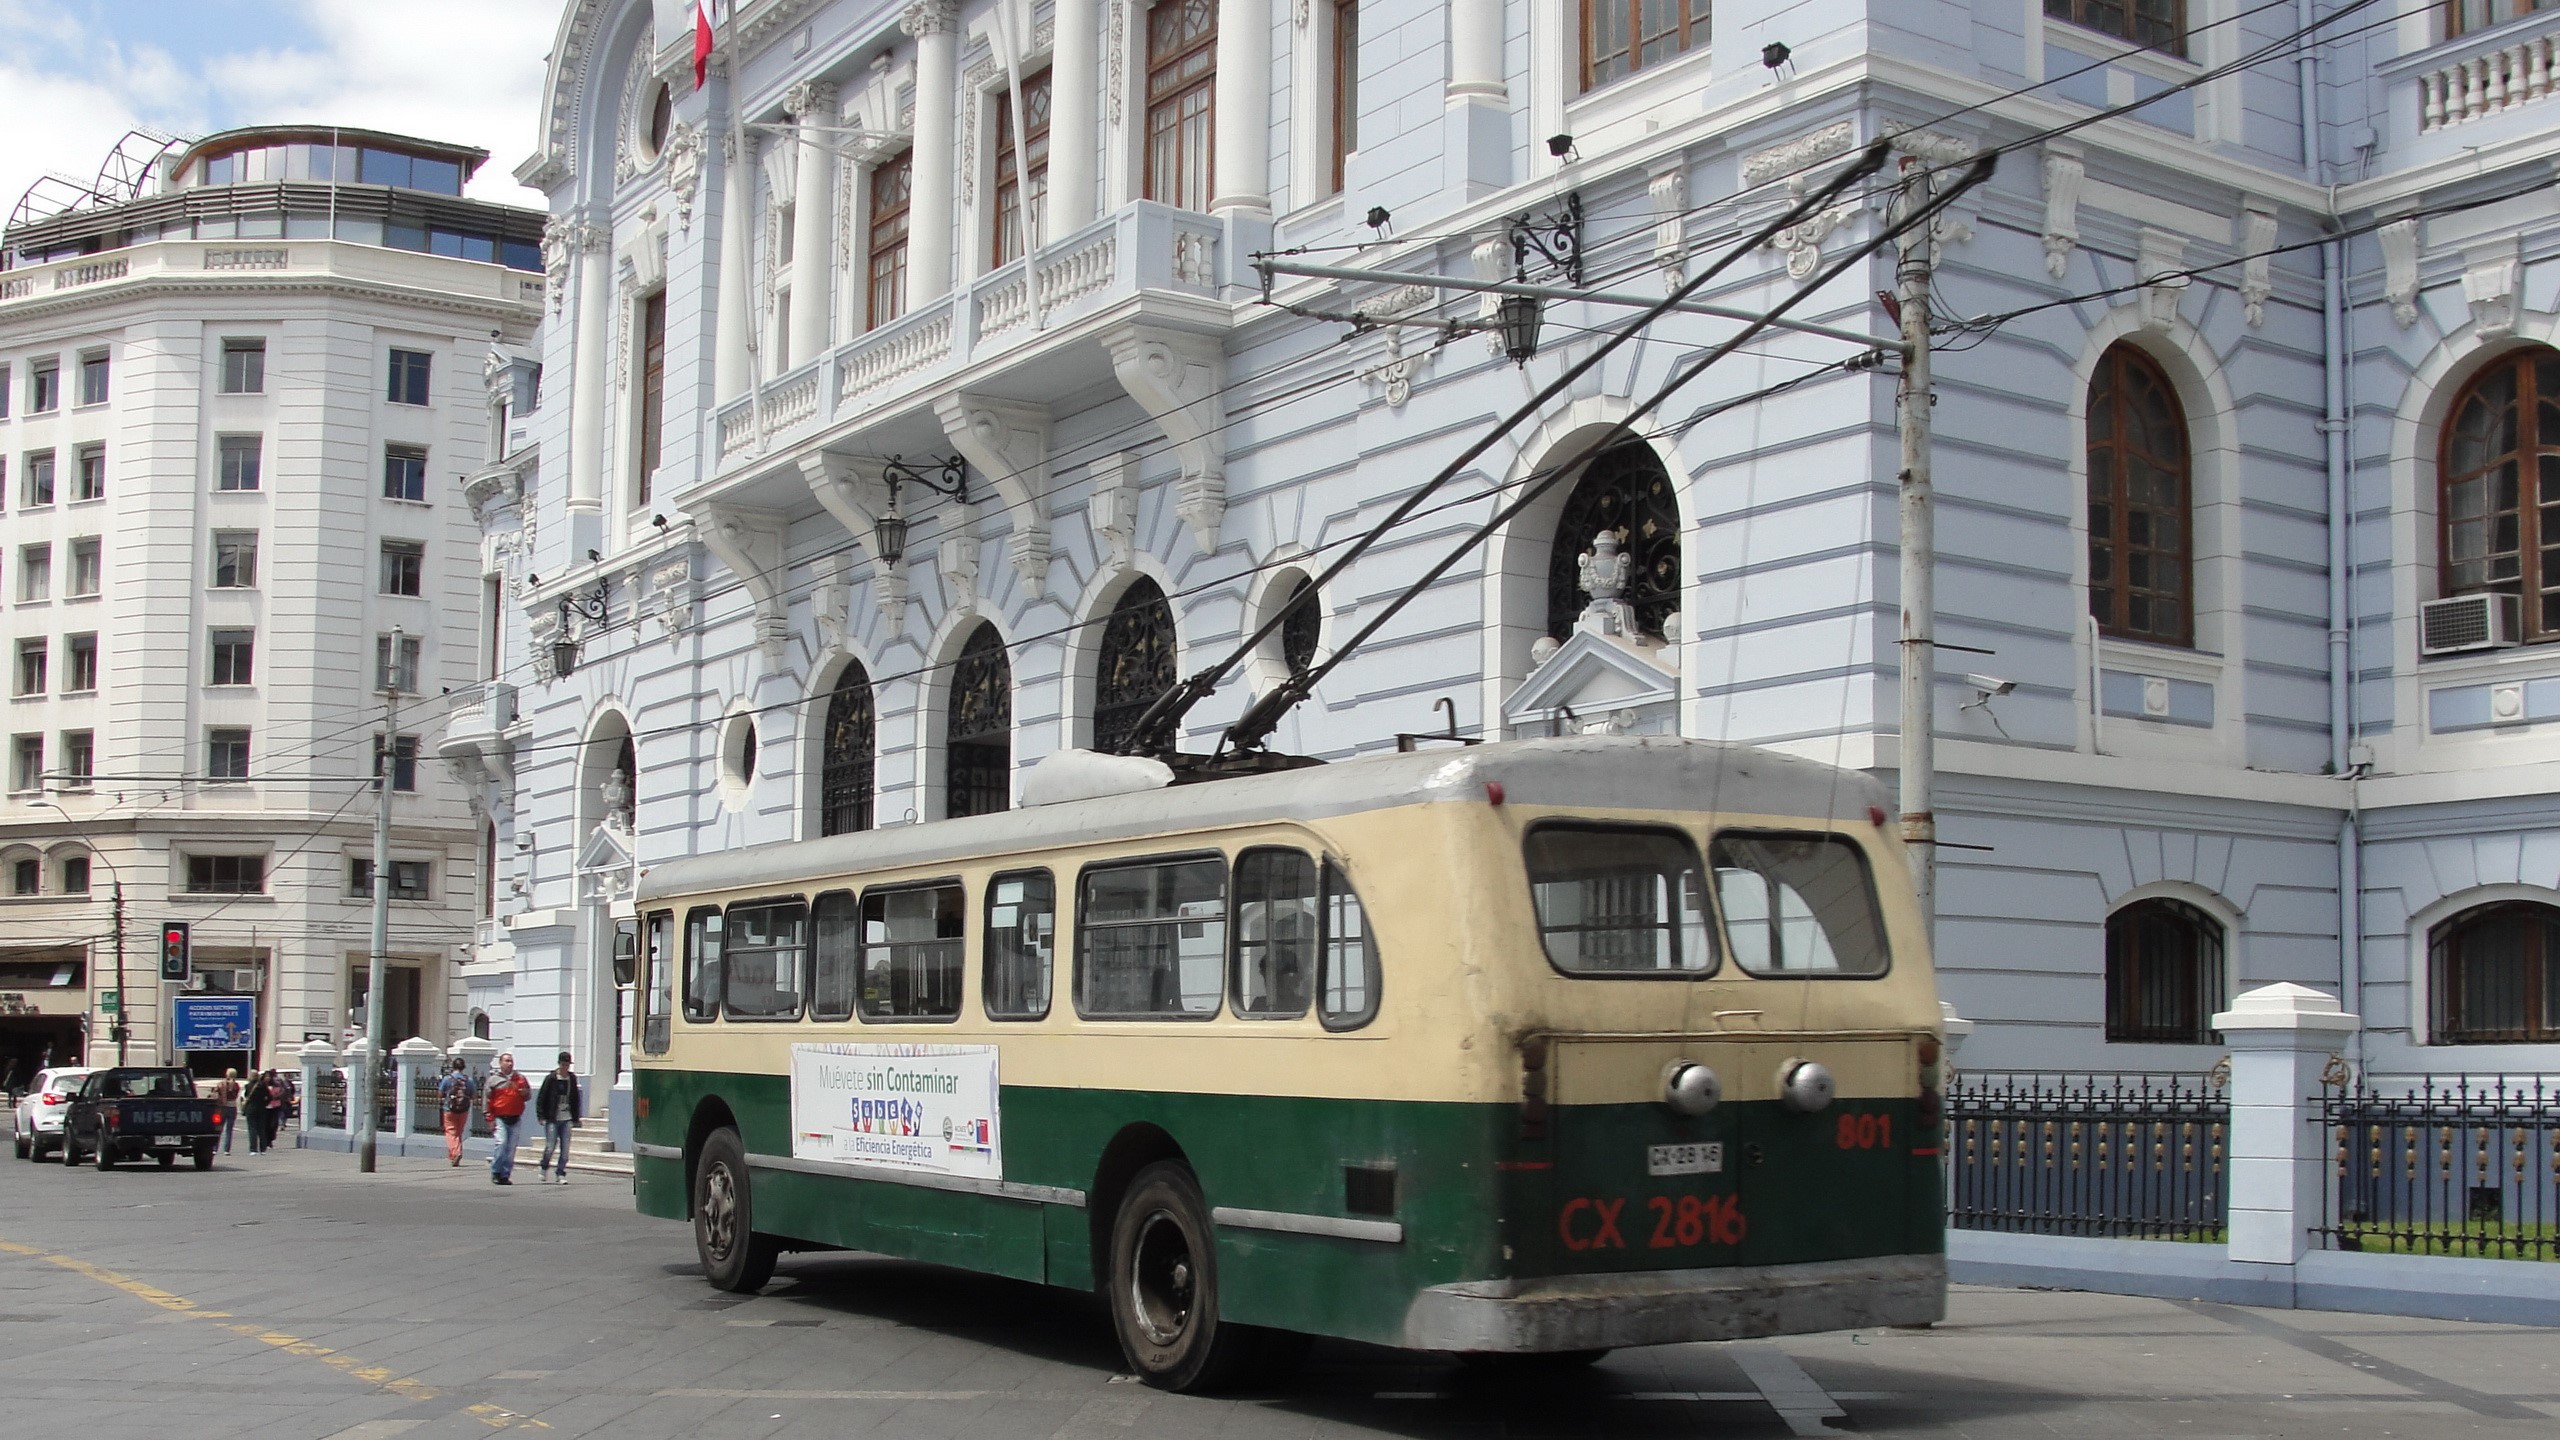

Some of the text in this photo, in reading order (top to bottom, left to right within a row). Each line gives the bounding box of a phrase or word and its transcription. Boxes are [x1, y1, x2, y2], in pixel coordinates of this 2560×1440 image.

[819, 1064, 959, 1095] Muévete sin Contaminar
[133, 1111, 203, 1123] NISSAN
[1835, 1113, 1892, 1150] 801
[843, 1137, 932, 1160] a la Eficiencia Energética
[1558, 1192, 1748, 1251] CX 2816
